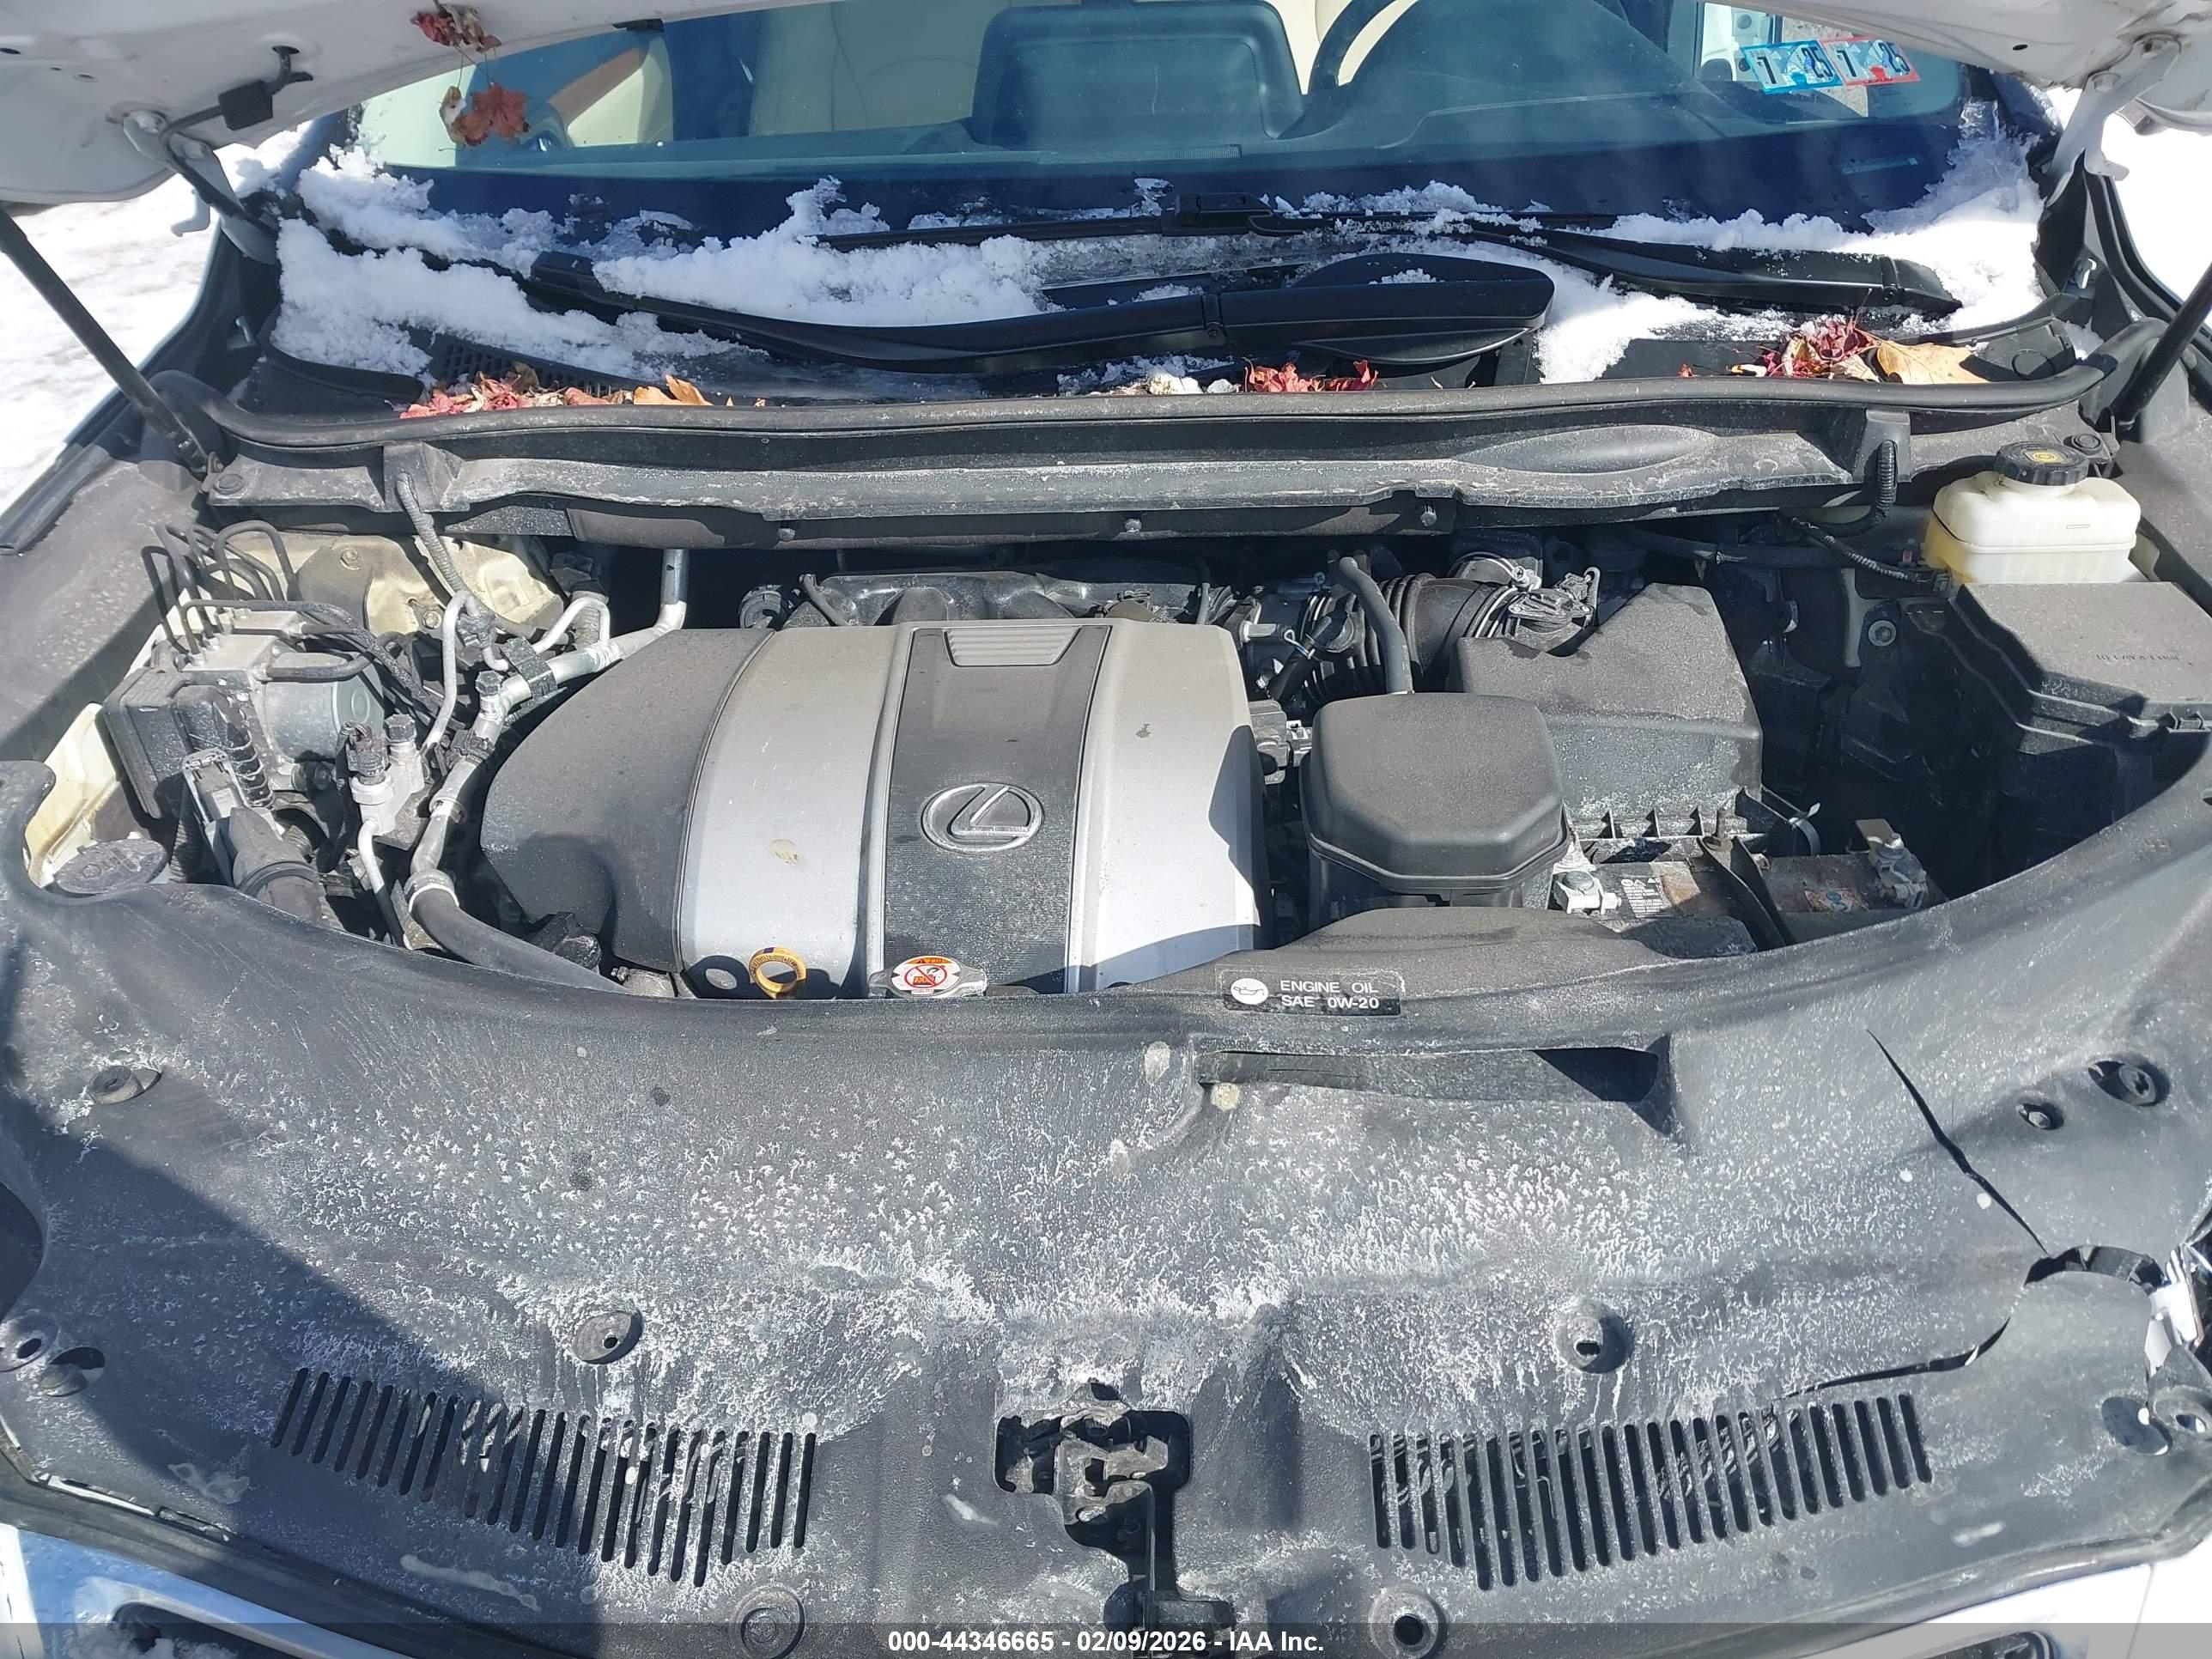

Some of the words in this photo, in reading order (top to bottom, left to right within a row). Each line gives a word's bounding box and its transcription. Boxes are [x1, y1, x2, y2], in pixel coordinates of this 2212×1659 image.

[1801, 47, 1832, 78] 25
[1878, 42, 1911, 75] 25
[1279, 980, 1340, 993] ENGINE
[1352, 981, 1379, 994] OIL
[1281, 995, 1316, 1007] SAE
[1328, 996, 1380, 1009] 0W-20
